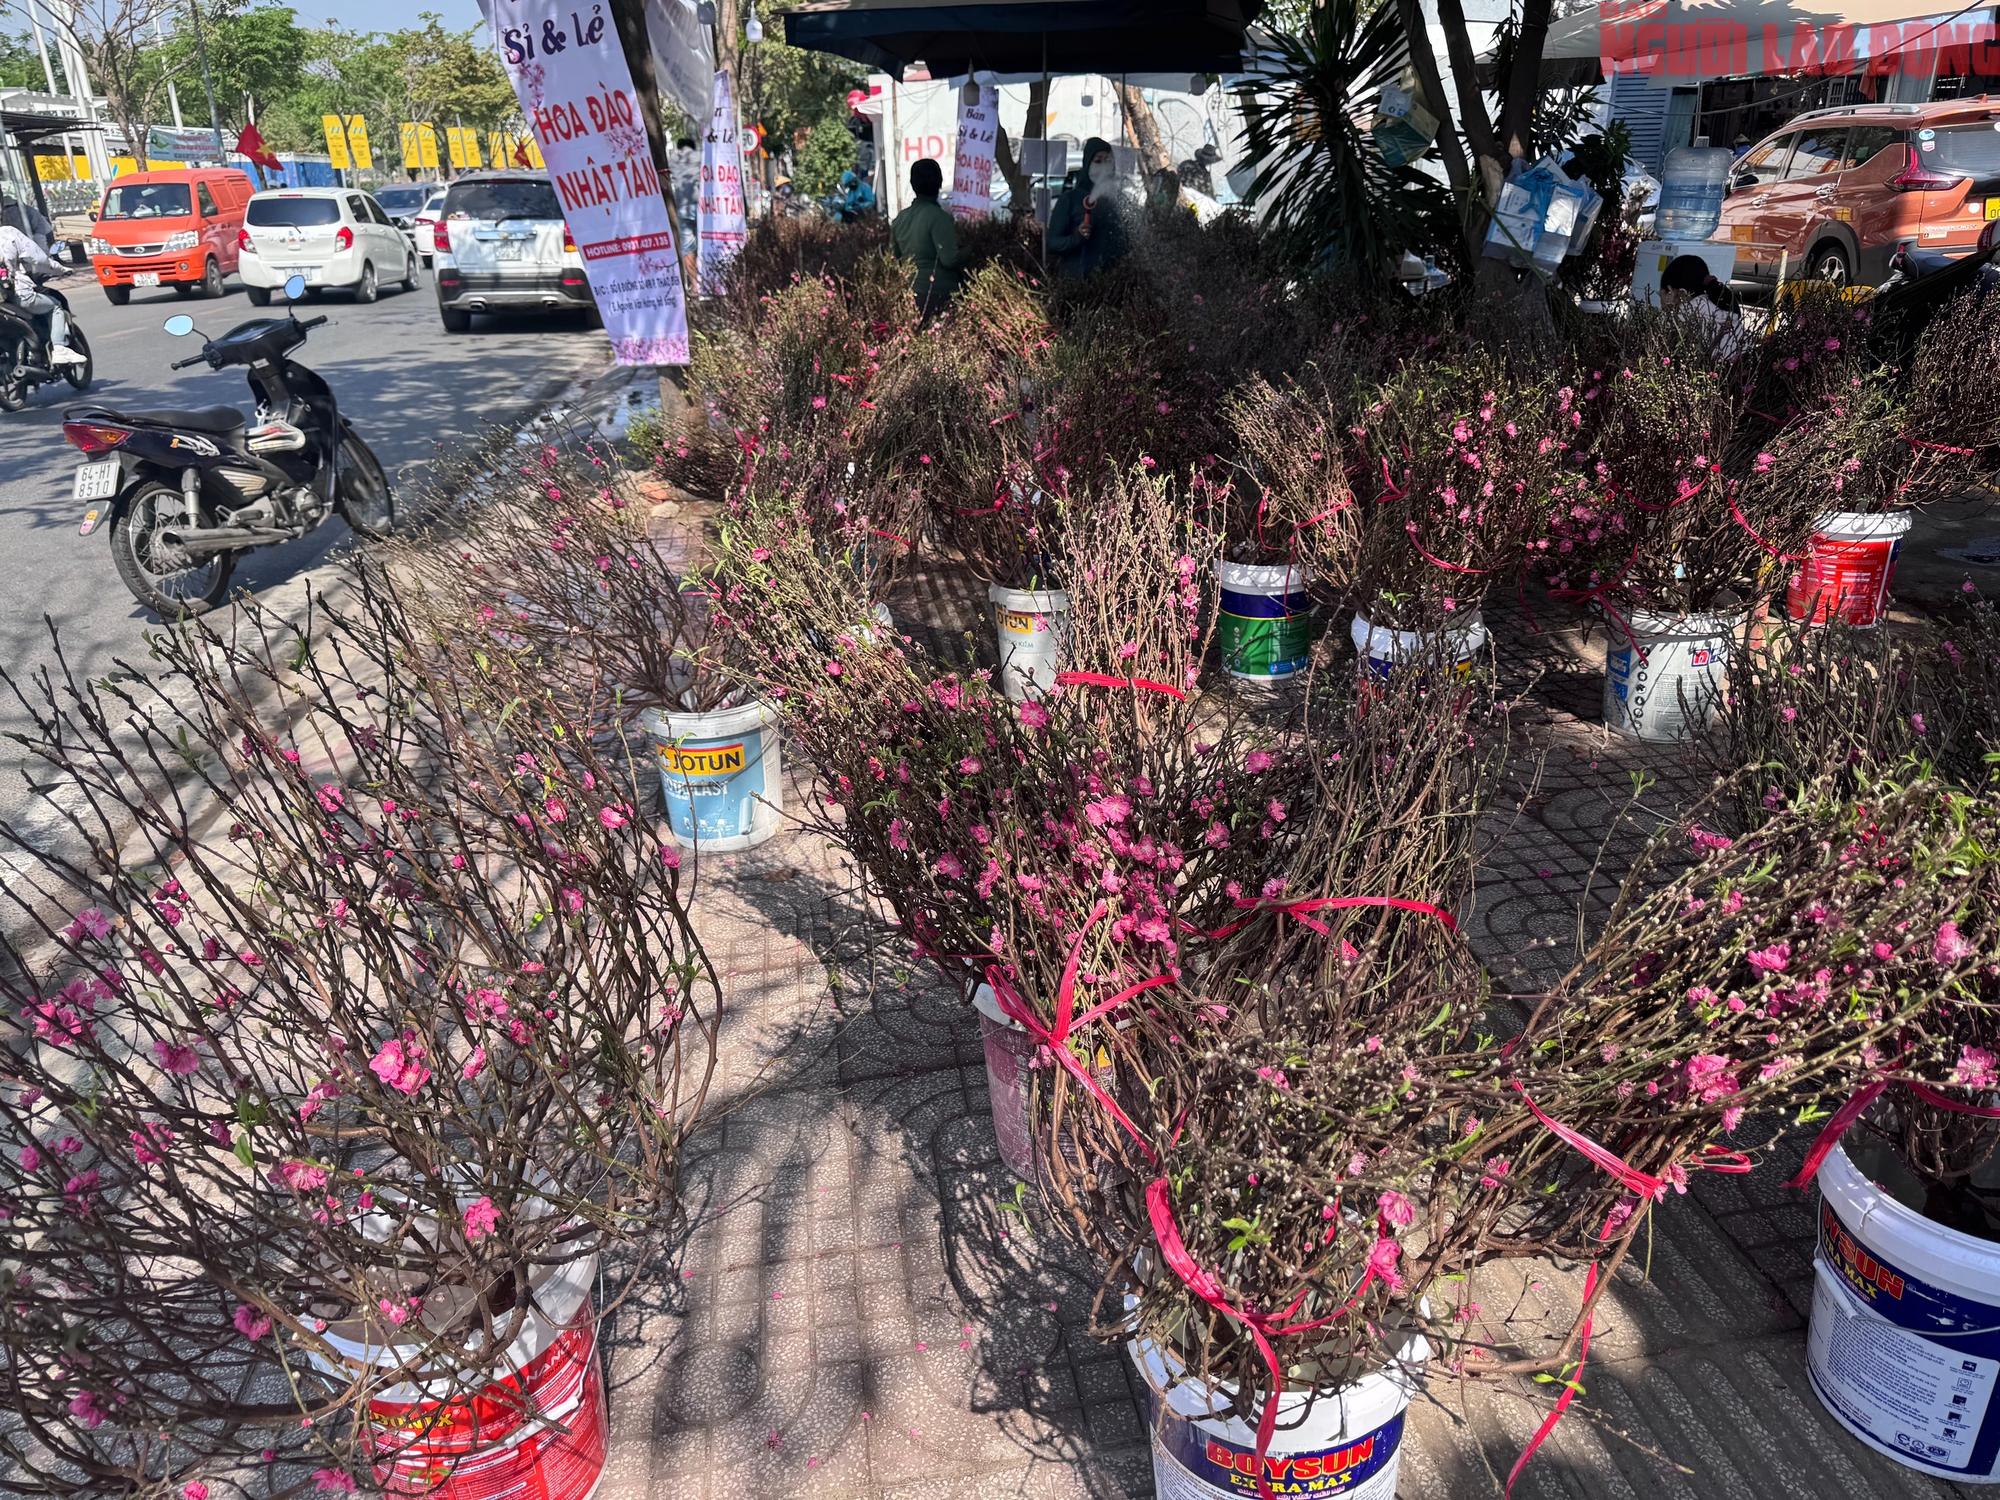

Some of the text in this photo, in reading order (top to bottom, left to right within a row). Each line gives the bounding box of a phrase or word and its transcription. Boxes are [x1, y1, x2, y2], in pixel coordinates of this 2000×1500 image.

[504, 23, 535, 64] Sỉ
[542, 19, 566, 55] &
[534, 81, 633, 145] HOA ĐÀO
[969, 128, 978, 139] &
[556, 147, 659, 216] NHẬT TÂN
[82, 464, 110, 481] 64-H1
[79, 481, 109, 497] 8510
[673, 751, 741, 771] JOTUN
[1844, 1265, 1878, 1300] MAX
[1206, 1435, 1374, 1480] BOYSUN
[1230, 1471, 1352, 1493] EXRA MAX
